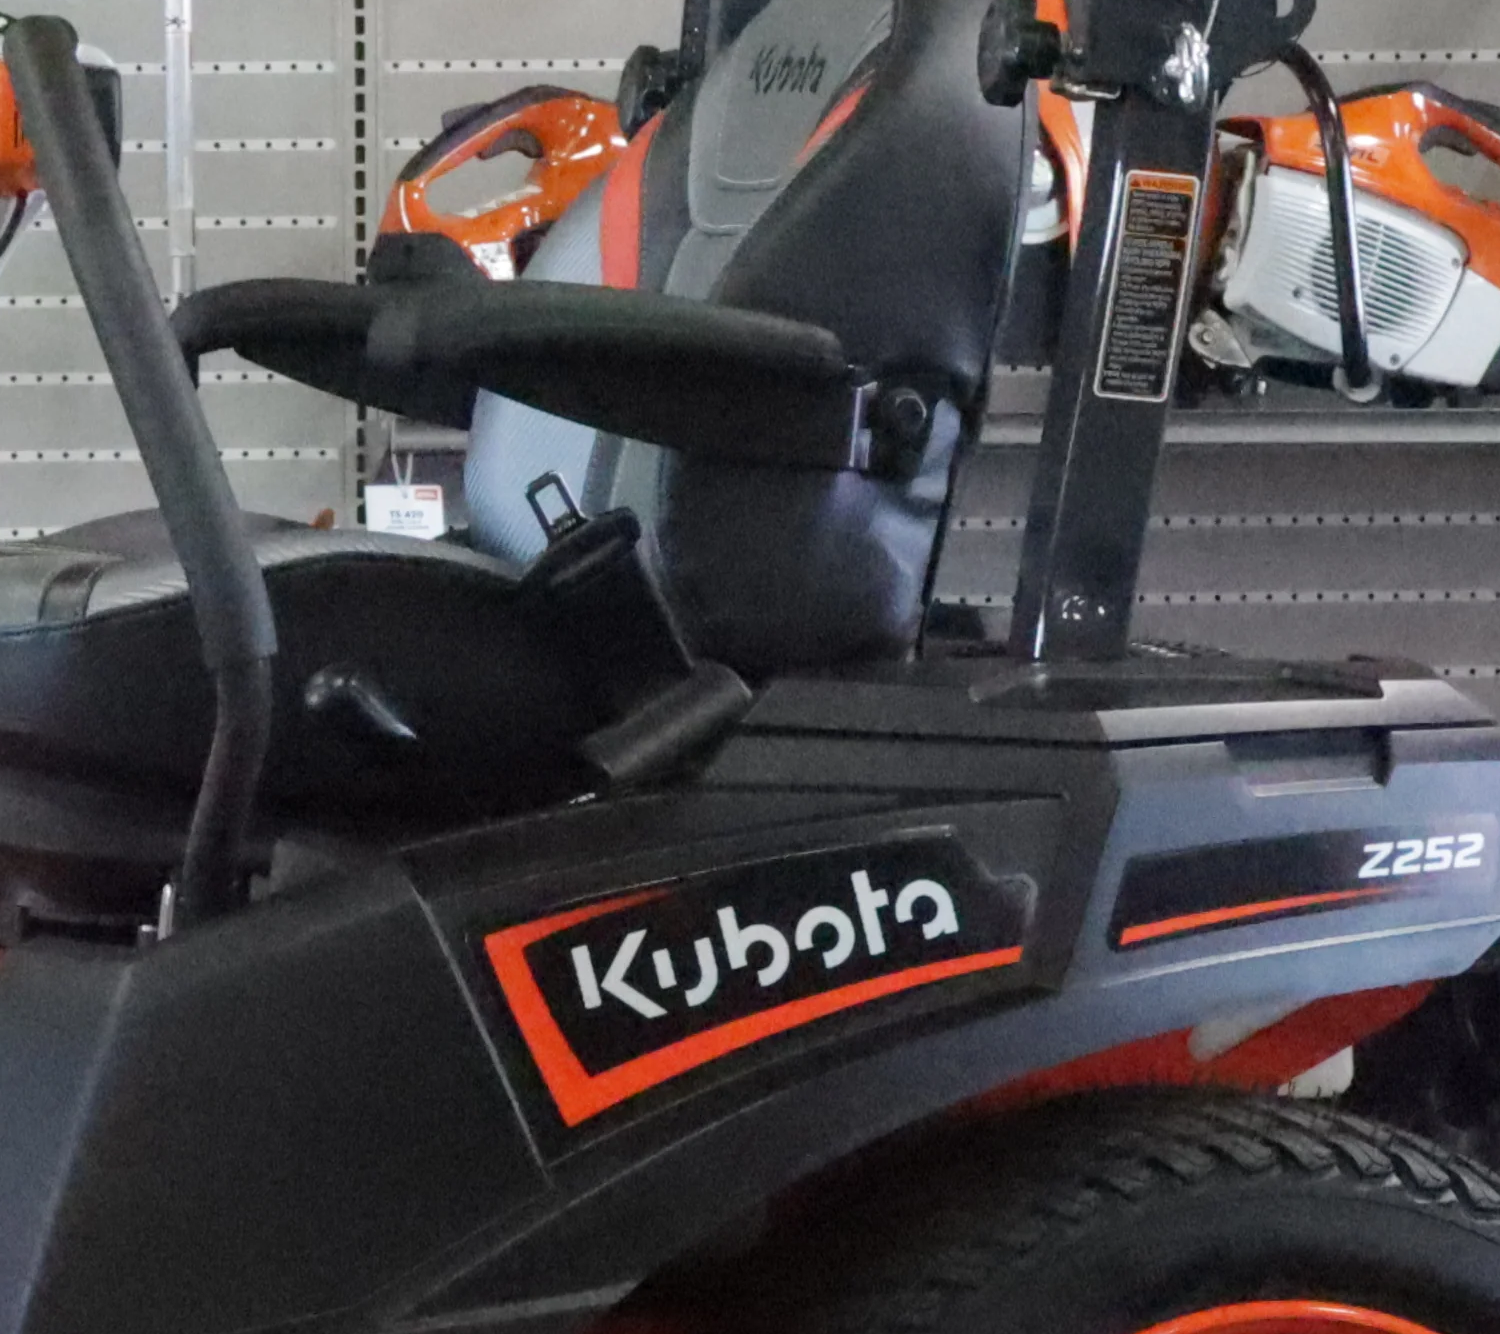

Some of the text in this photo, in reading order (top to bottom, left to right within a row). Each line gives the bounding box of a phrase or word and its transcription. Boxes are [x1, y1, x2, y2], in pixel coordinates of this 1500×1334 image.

[750, 44, 827, 95] Kubota
[1358, 832, 1484, 879] Z252
[571, 870, 958, 1019] Kubota
